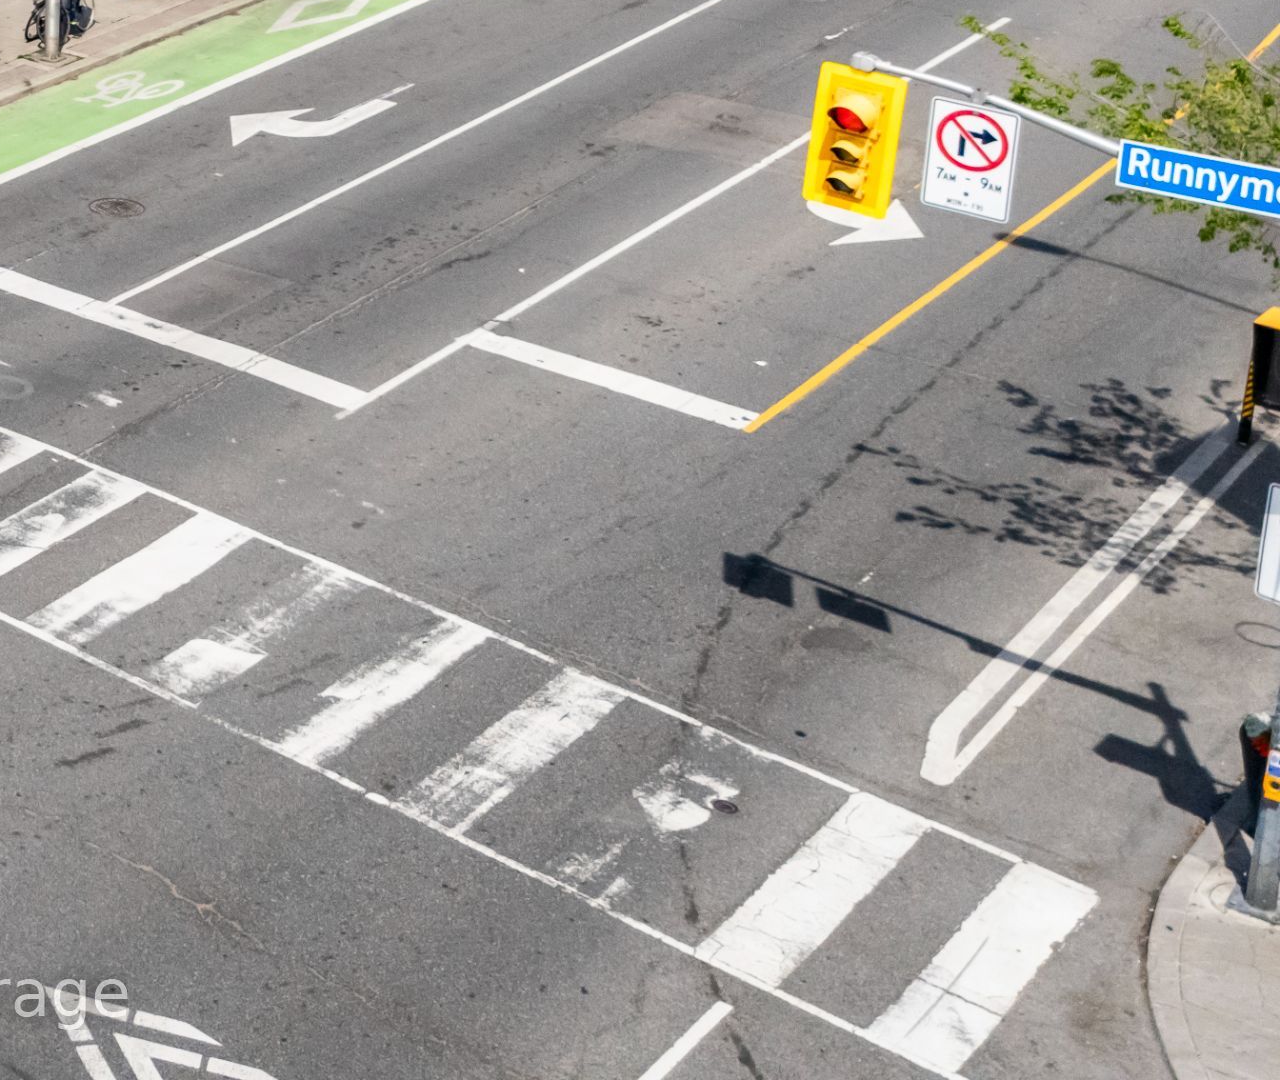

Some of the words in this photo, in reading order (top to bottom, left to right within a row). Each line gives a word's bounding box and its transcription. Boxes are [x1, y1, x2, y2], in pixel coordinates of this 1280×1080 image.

[936, 166, 956, 181] 7AM
[980, 177, 1002, 192] 9AM
[1127, 146, 1280, 205] Runnym
